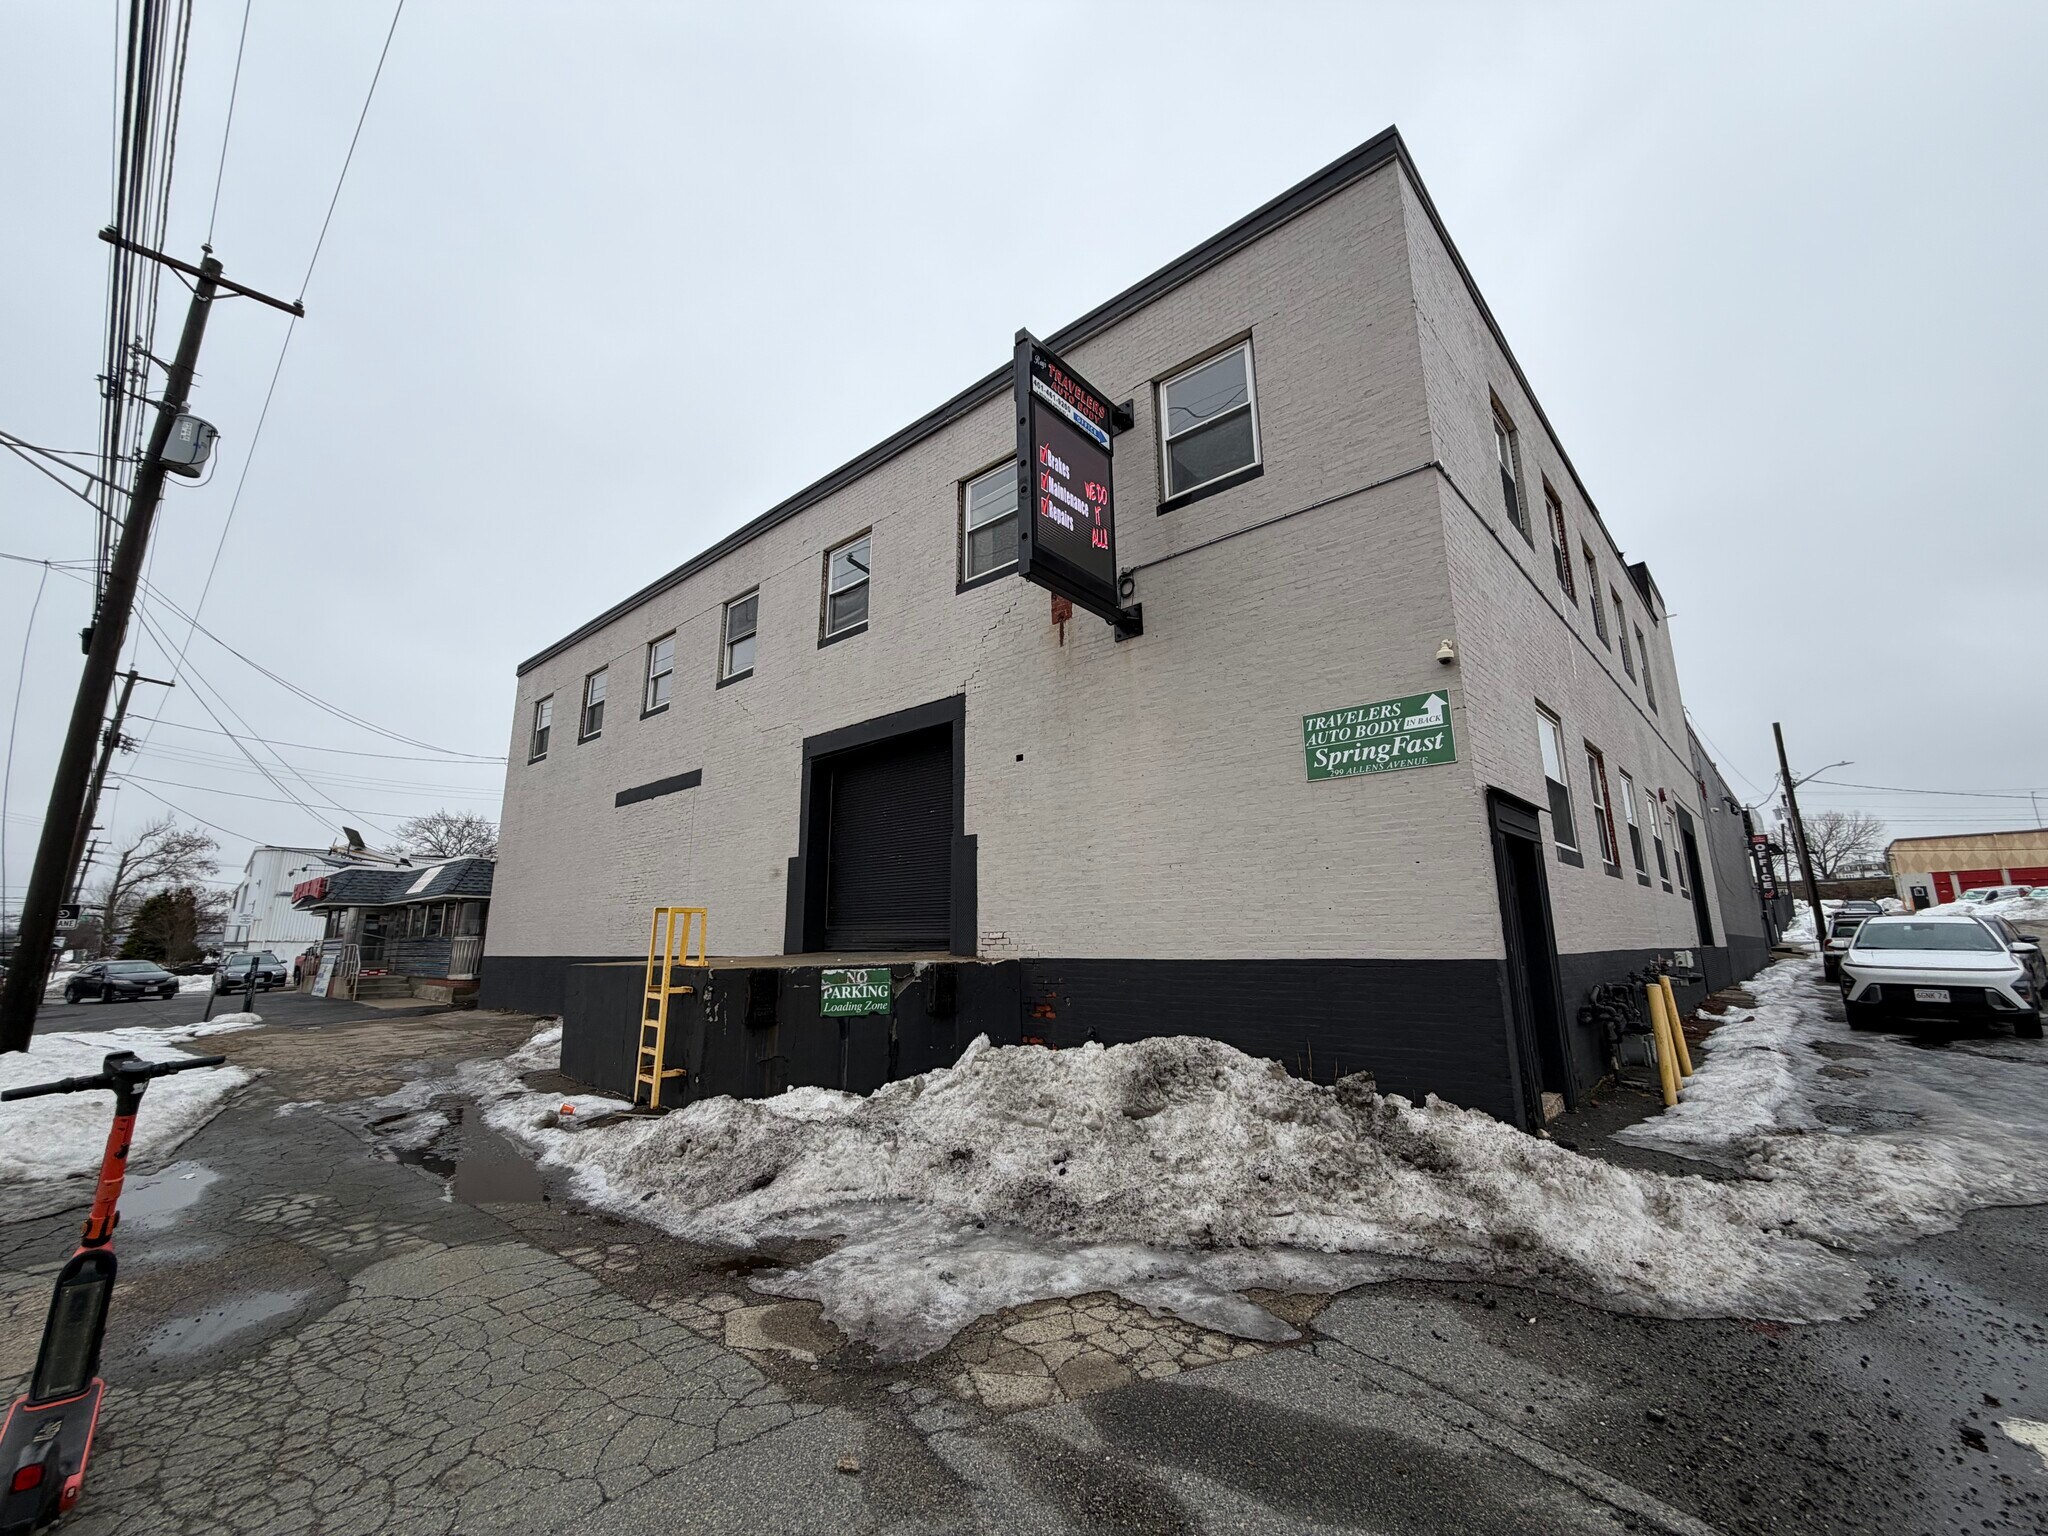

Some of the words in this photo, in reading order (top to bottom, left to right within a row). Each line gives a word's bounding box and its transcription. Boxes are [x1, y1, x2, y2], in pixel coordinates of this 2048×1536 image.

[1048, 363, 1105, 419] TRAVELERS
[1051, 381, 1075, 405] AUTO
[1077, 401, 1100, 424] BODY
[1076, 416, 1097, 435] OFFICE
[1047, 449, 1070, 480] Brakes
[1048, 475, 1089, 518] Maintenance
[1084, 480, 1097, 501] WE
[1096, 483, 1108, 506] DO
[1048, 500, 1074, 531] Repairs
[1094, 506, 1102, 526] IT
[1306, 702, 1402, 732] TRAVELERS
[1406, 717, 1416, 727] IN
[1418, 714, 1442, 725] BACK
[1306, 727, 1351, 747] AUTO
[1355, 718, 1403, 739] BODY
[1313, 731, 1445, 771] SpringFast
[1329, 768, 1344, 777] 299
[1346, 762, 1385, 775] ALLENS
[1386, 756, 1429, 770] AVENUE
[1754, 843, 1773, 889] OFFICE
[56, 919, 75, 927] ANE
[846, 970, 868, 984] NO
[823, 984, 889, 999] PARKING
[823, 1002, 862, 1013] Loading
[864, 1000, 888, 1010] Zone
